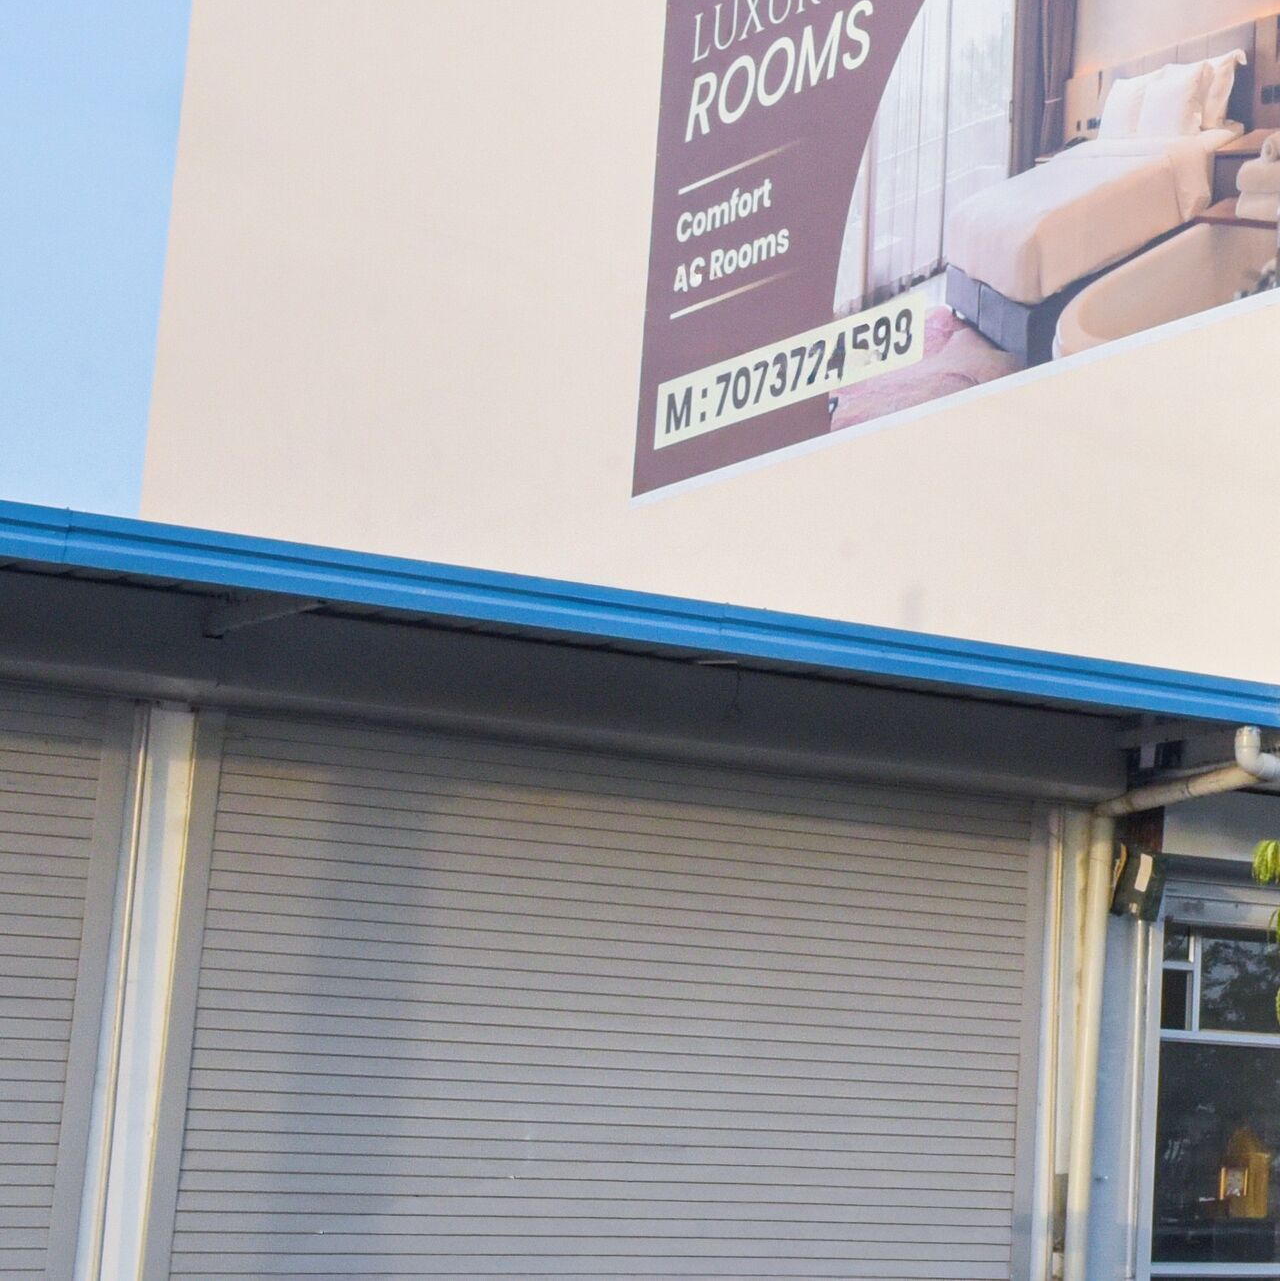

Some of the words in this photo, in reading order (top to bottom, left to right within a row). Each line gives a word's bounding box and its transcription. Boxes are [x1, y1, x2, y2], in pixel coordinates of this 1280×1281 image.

[684, 0, 874, 144] ROOMS
[676, 178, 773, 243] Comfort
[709, 228, 790, 281] Rooms
